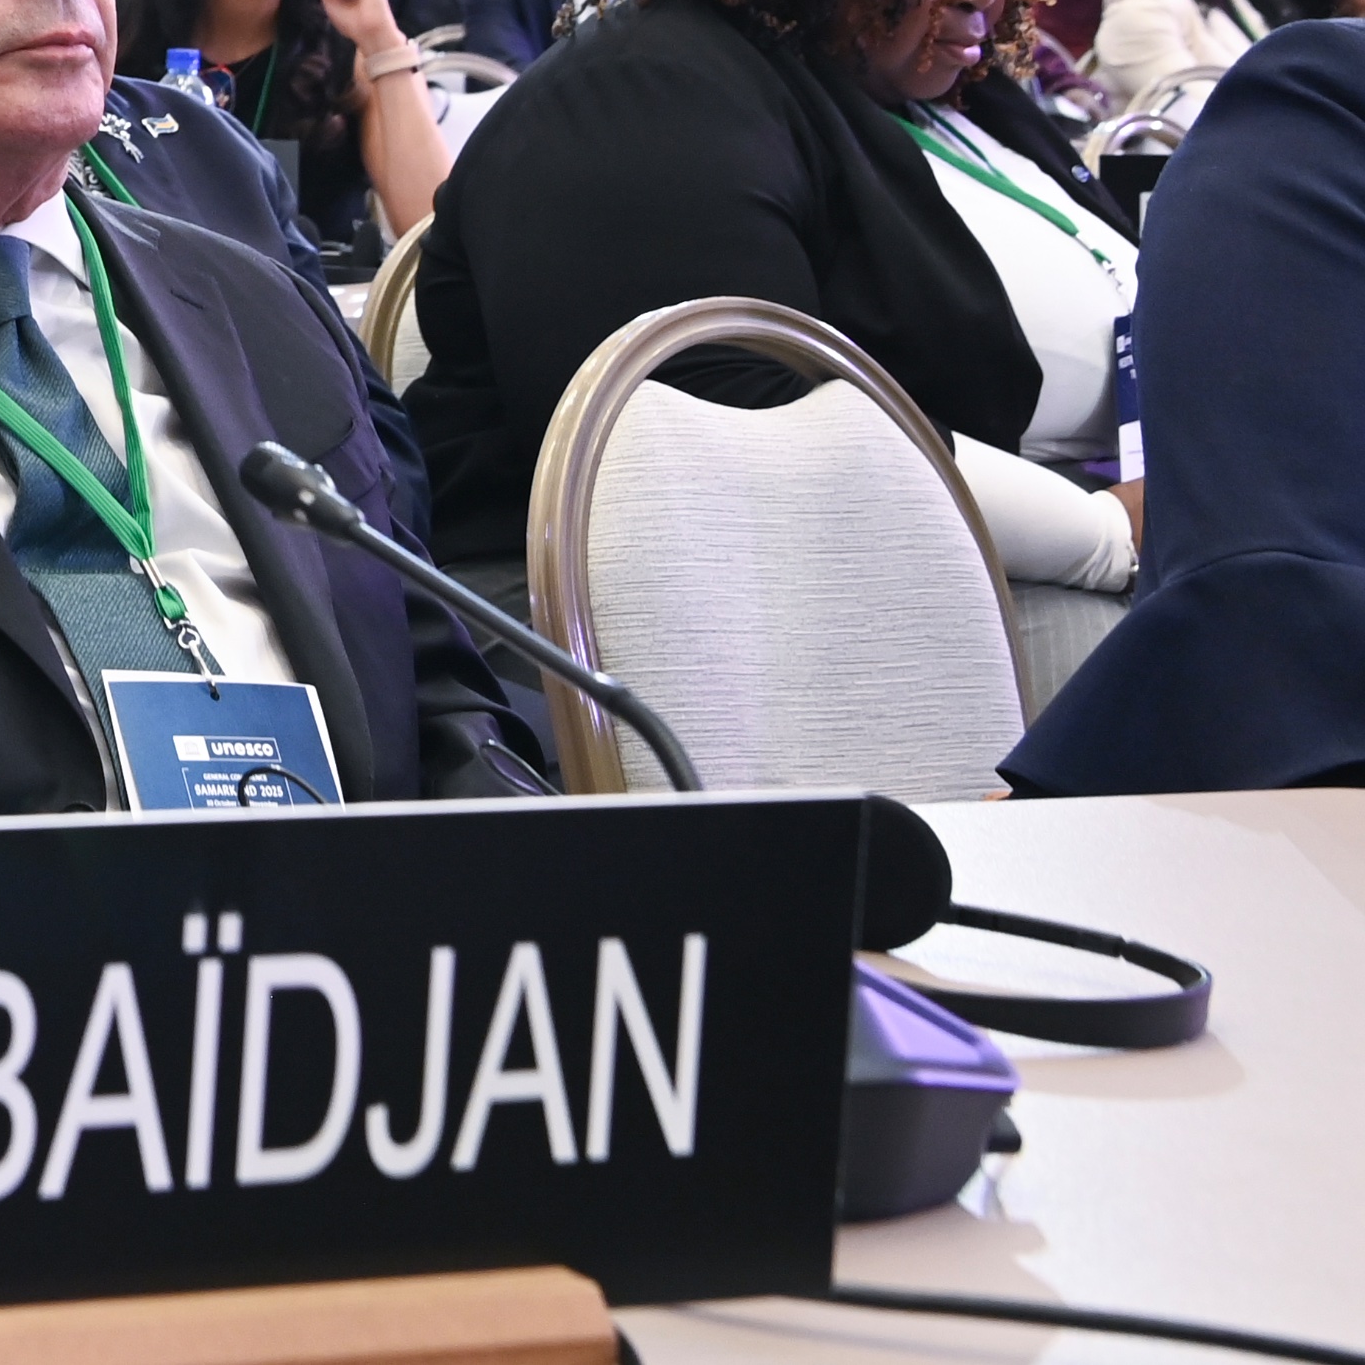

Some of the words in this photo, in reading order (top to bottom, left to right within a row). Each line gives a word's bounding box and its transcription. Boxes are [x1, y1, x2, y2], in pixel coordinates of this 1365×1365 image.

[211, 742, 274, 757] unesco
[194, 783, 257, 797] SAMARKND
[260, 785, 283, 798] 2025
